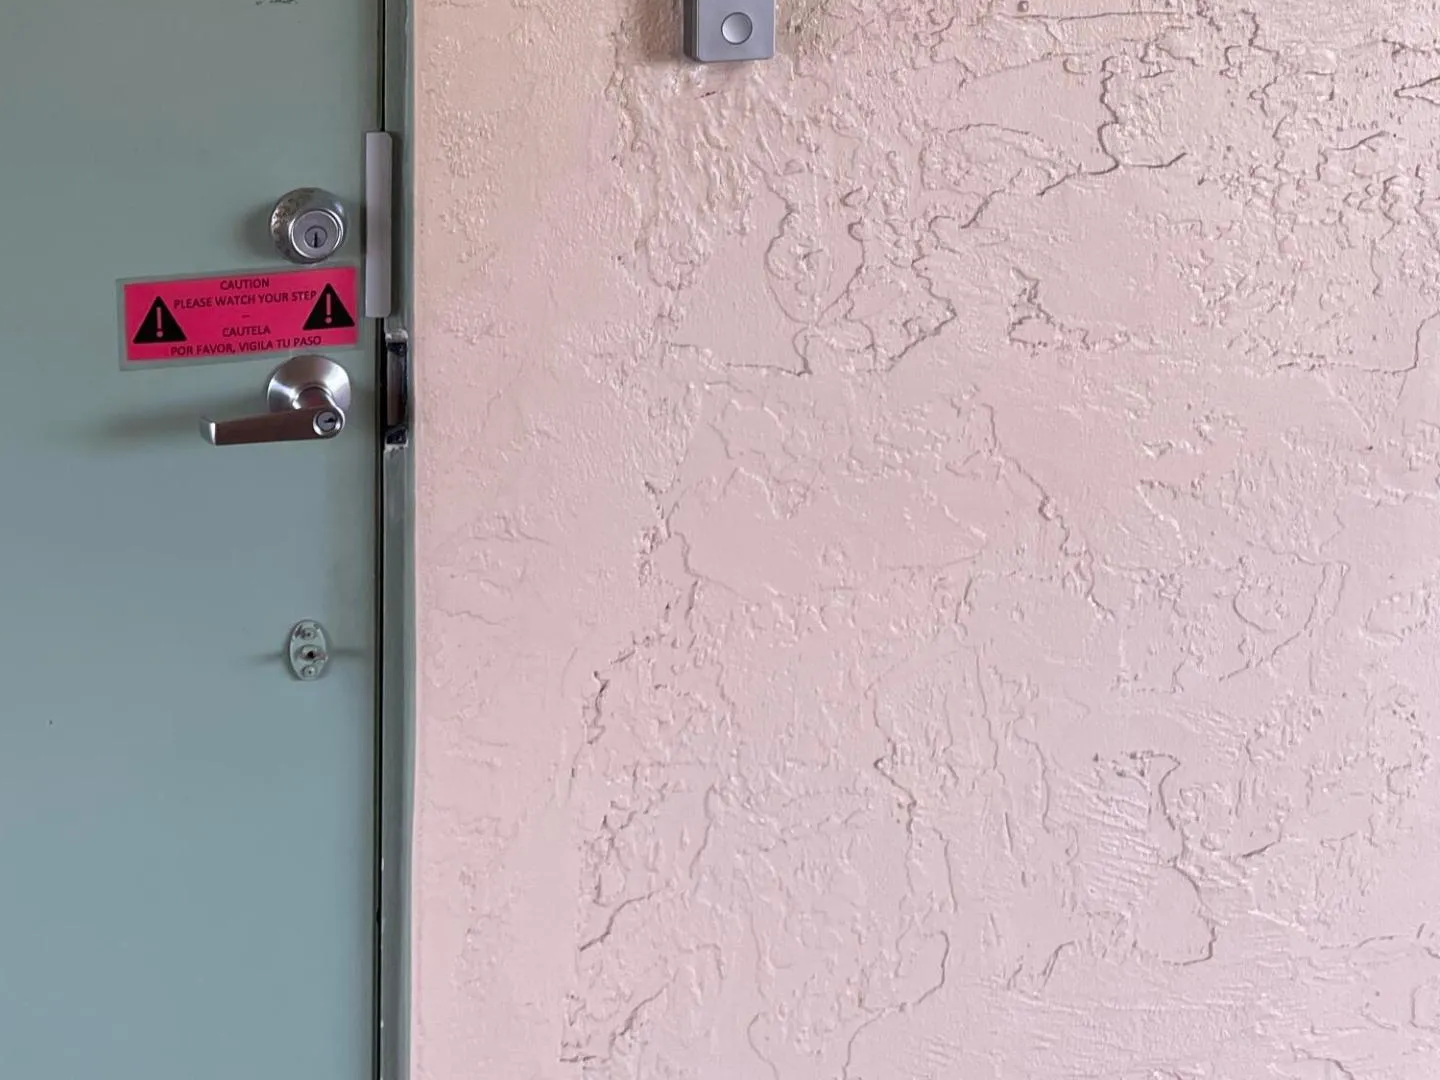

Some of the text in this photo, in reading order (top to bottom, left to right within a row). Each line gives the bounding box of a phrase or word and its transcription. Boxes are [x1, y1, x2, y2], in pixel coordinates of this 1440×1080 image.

[219, 277, 270, 291] CAUTION
[173, 289, 317, 310] PLEASE WATCH YOUR STEP
[222, 324, 272, 338] CAUTELA
[170, 335, 322, 357] POR FAVOR, VIGILA TU PASO
